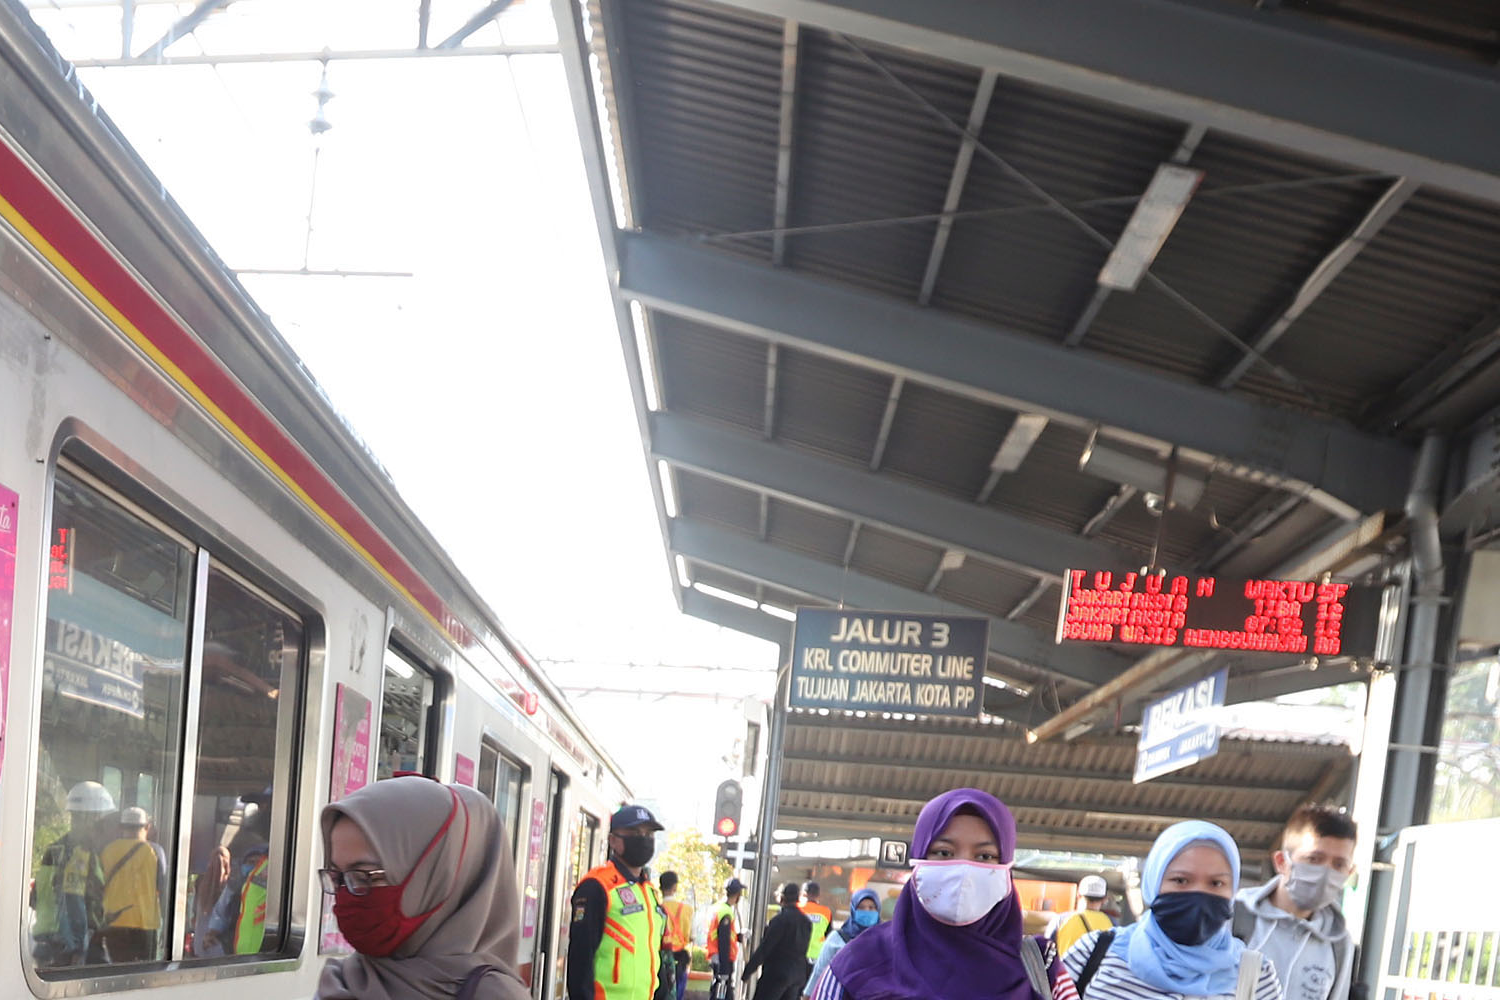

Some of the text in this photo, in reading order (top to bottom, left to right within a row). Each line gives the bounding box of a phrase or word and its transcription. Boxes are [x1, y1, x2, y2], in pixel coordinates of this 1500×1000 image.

[1245, 579, 1316, 603] WAKTU
[830, 616, 950, 648] JALUR 3
[803, 648, 975, 680] KRL COMMUTER LINE
[797, 676, 975, 709] TUJUAN JAKARTA KOTA PP
